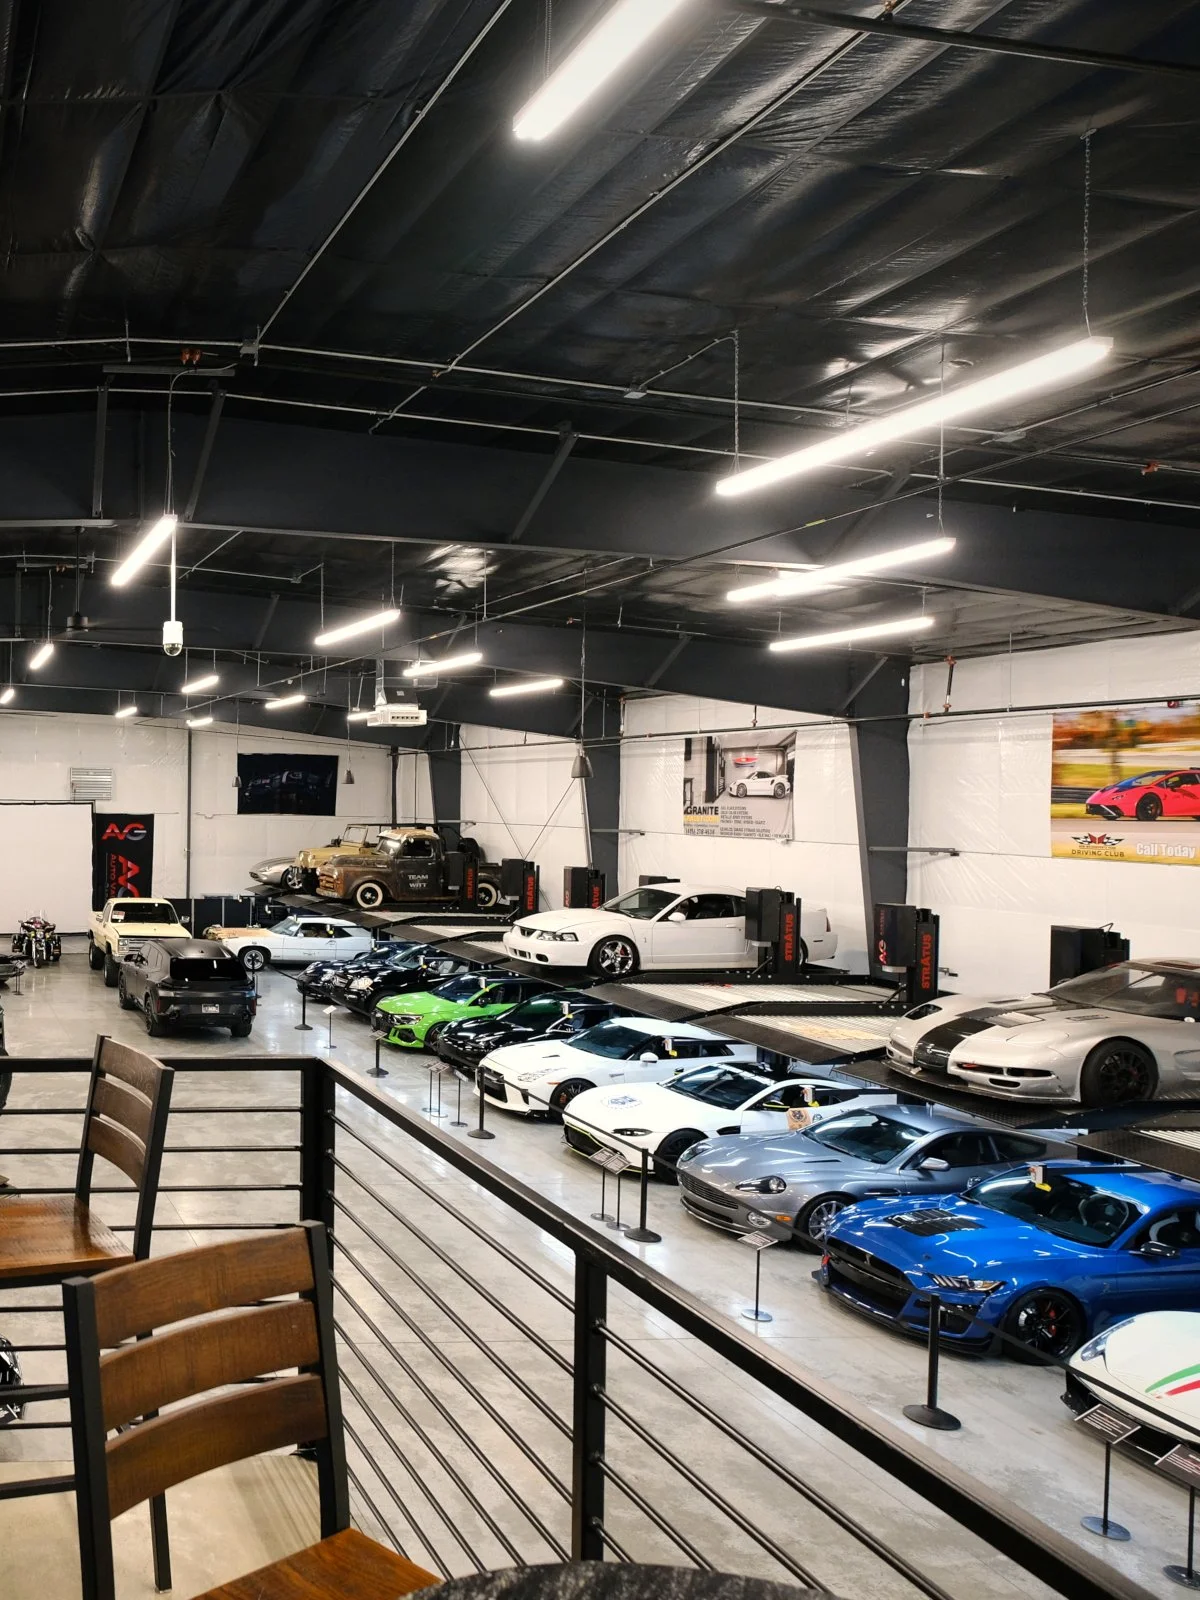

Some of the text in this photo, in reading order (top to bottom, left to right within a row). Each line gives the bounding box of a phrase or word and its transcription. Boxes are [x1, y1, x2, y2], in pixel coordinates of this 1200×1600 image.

[686, 806, 719, 815] GRANITE
[1136, 843, 1196, 859] Call Today
[784, 913, 794, 961] STRATUS
[921, 934, 932, 989] STRATUS
